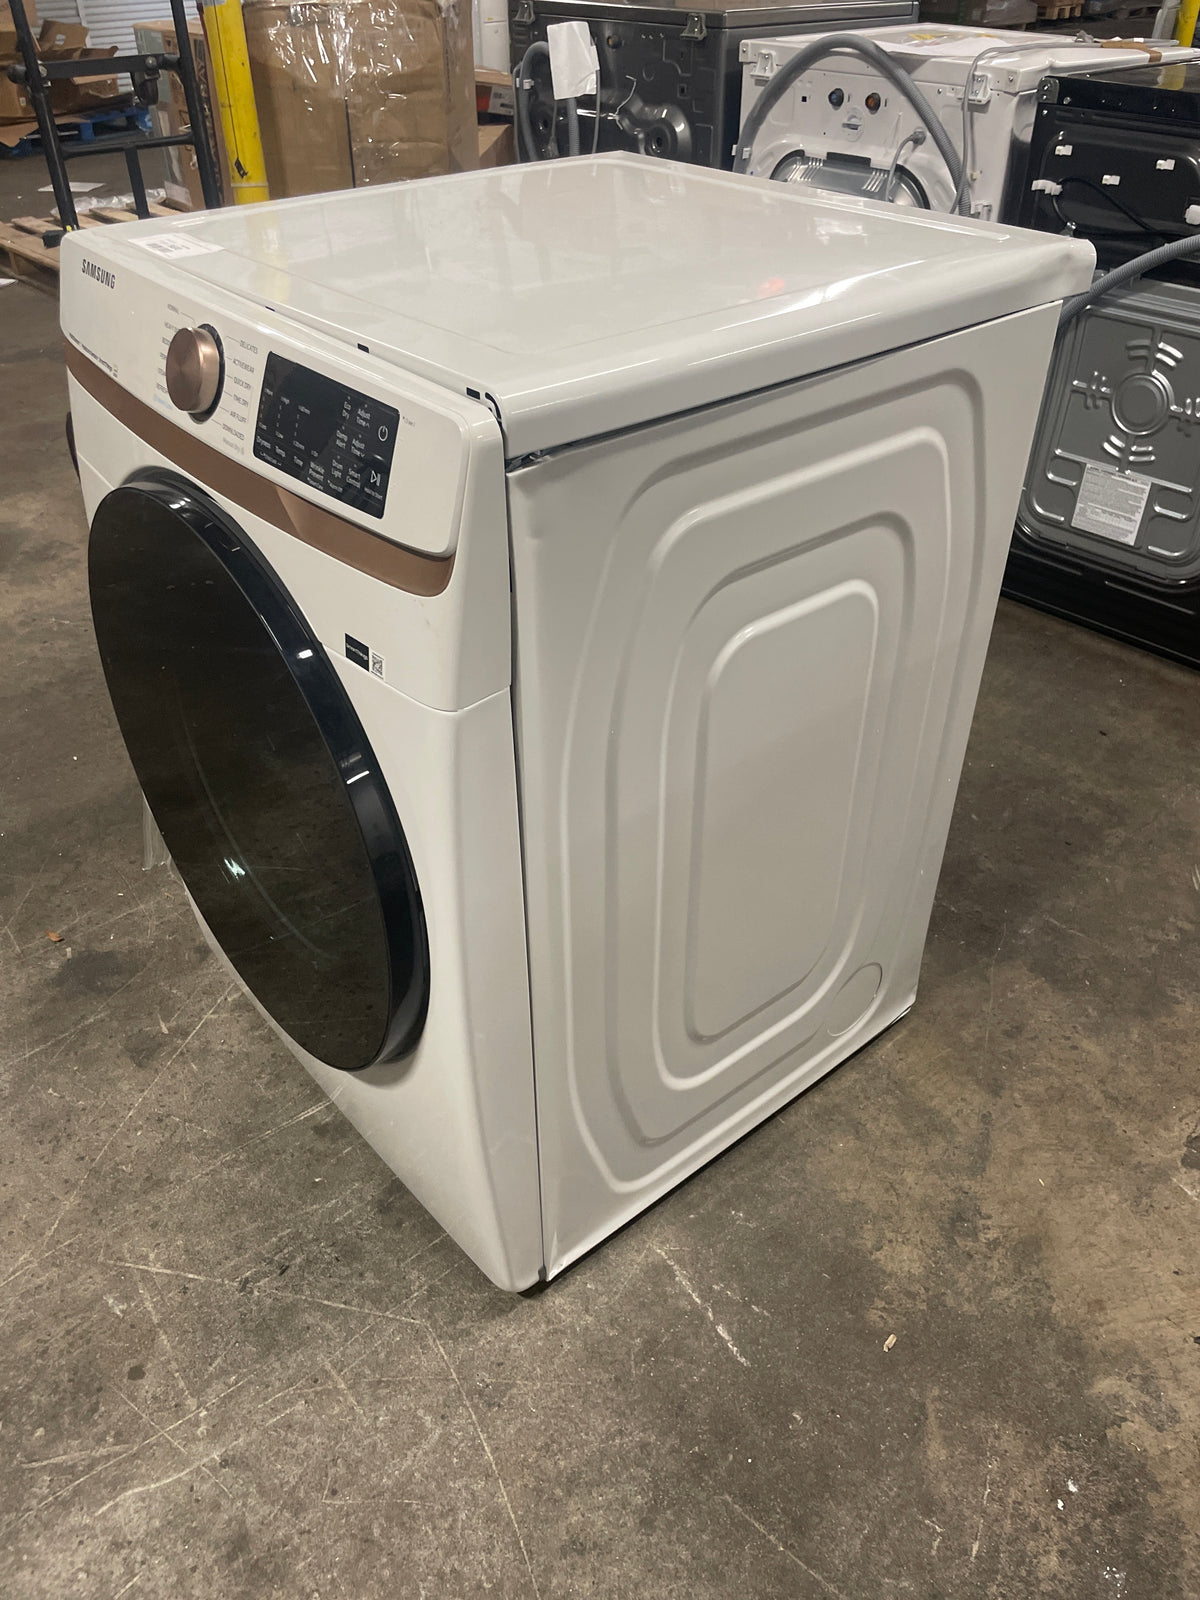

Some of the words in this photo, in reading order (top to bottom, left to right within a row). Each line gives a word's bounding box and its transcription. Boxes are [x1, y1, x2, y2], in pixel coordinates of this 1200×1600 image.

[81, 258, 116, 290] SAMSUNG
[342, 409, 350, 420] Dry
[357, 408, 371, 420] Adjust
[356, 416, 366, 427] Time
[336, 429, 348, 442] Damp
[335, 439, 346, 450] Alert
[352, 438, 366, 450] Adjust
[350, 446, 361, 457] Time
[332, 459, 343, 471] Drum
[331, 467, 342, 479] Light
[348, 468, 361, 479] Smart
[346, 475, 361, 489] Control
